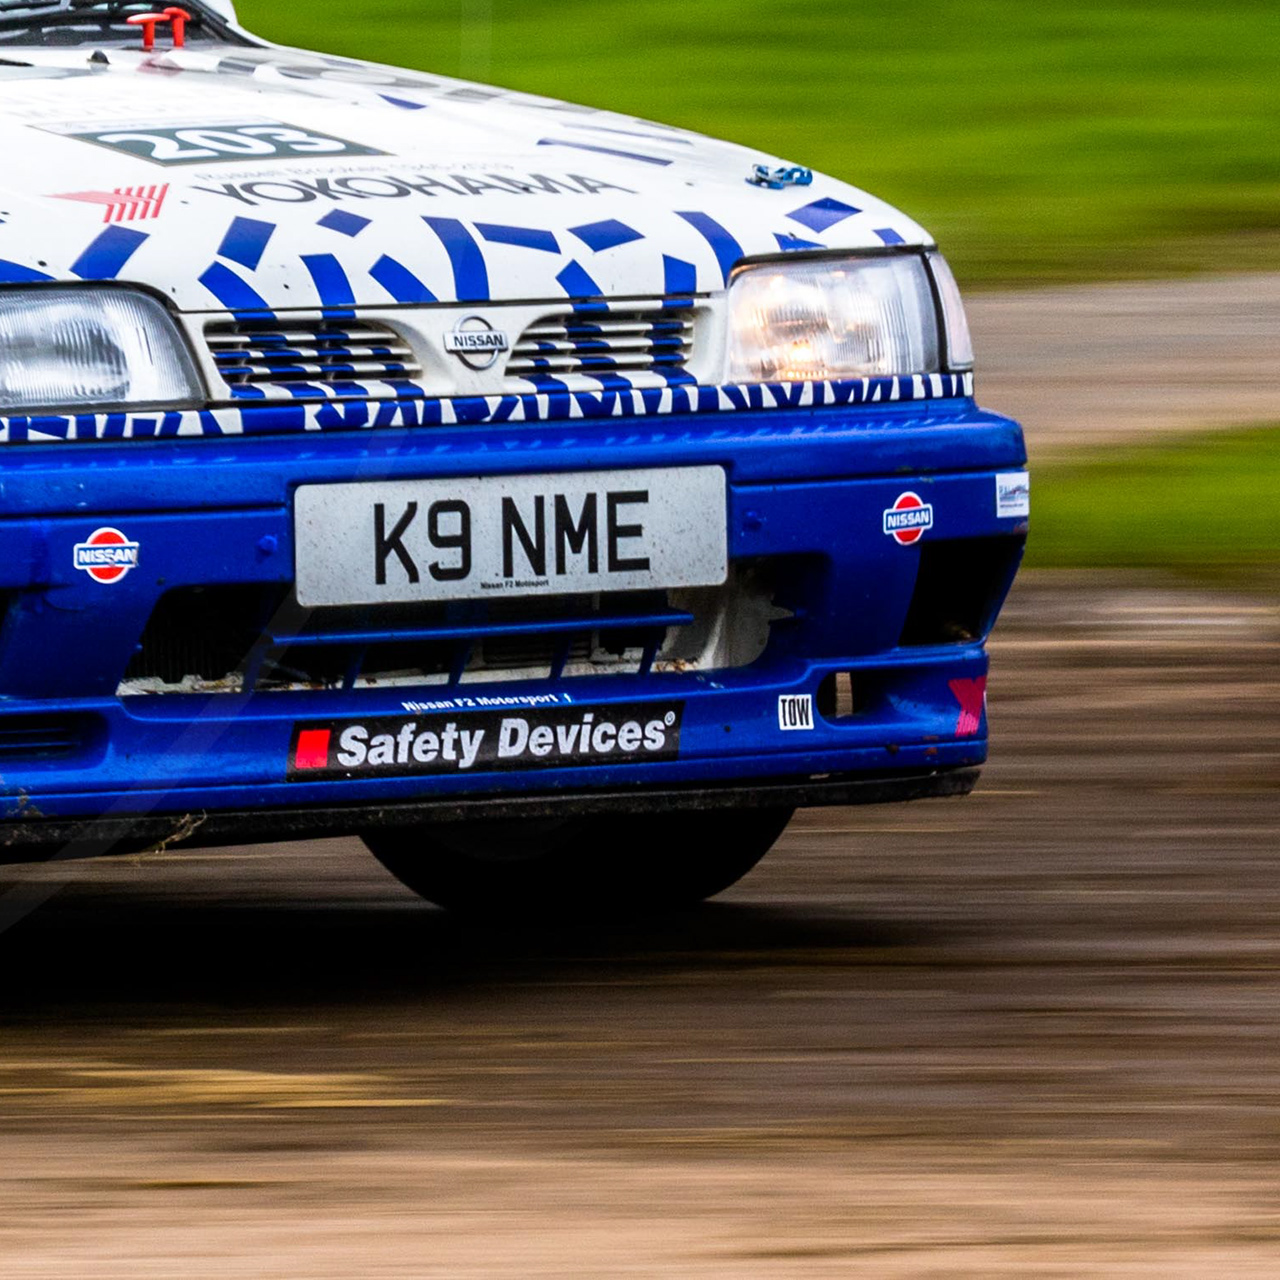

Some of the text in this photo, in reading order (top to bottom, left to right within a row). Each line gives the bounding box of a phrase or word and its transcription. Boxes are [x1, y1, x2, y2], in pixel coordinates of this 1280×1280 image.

[96, 126, 346, 160] 203
[190, 172, 638, 206] YOKOHAMA
[453, 333, 505, 348] NISSAN
[887, 510, 929, 528] NISSAN
[374, 490, 650, 586] K9 NME
[78, 548, 137, 564] NISSAN
[401, 693, 559, 712] Nissan F2 Motorsport
[780, 698, 811, 727] TOW
[336, 722, 483, 771] Safety
